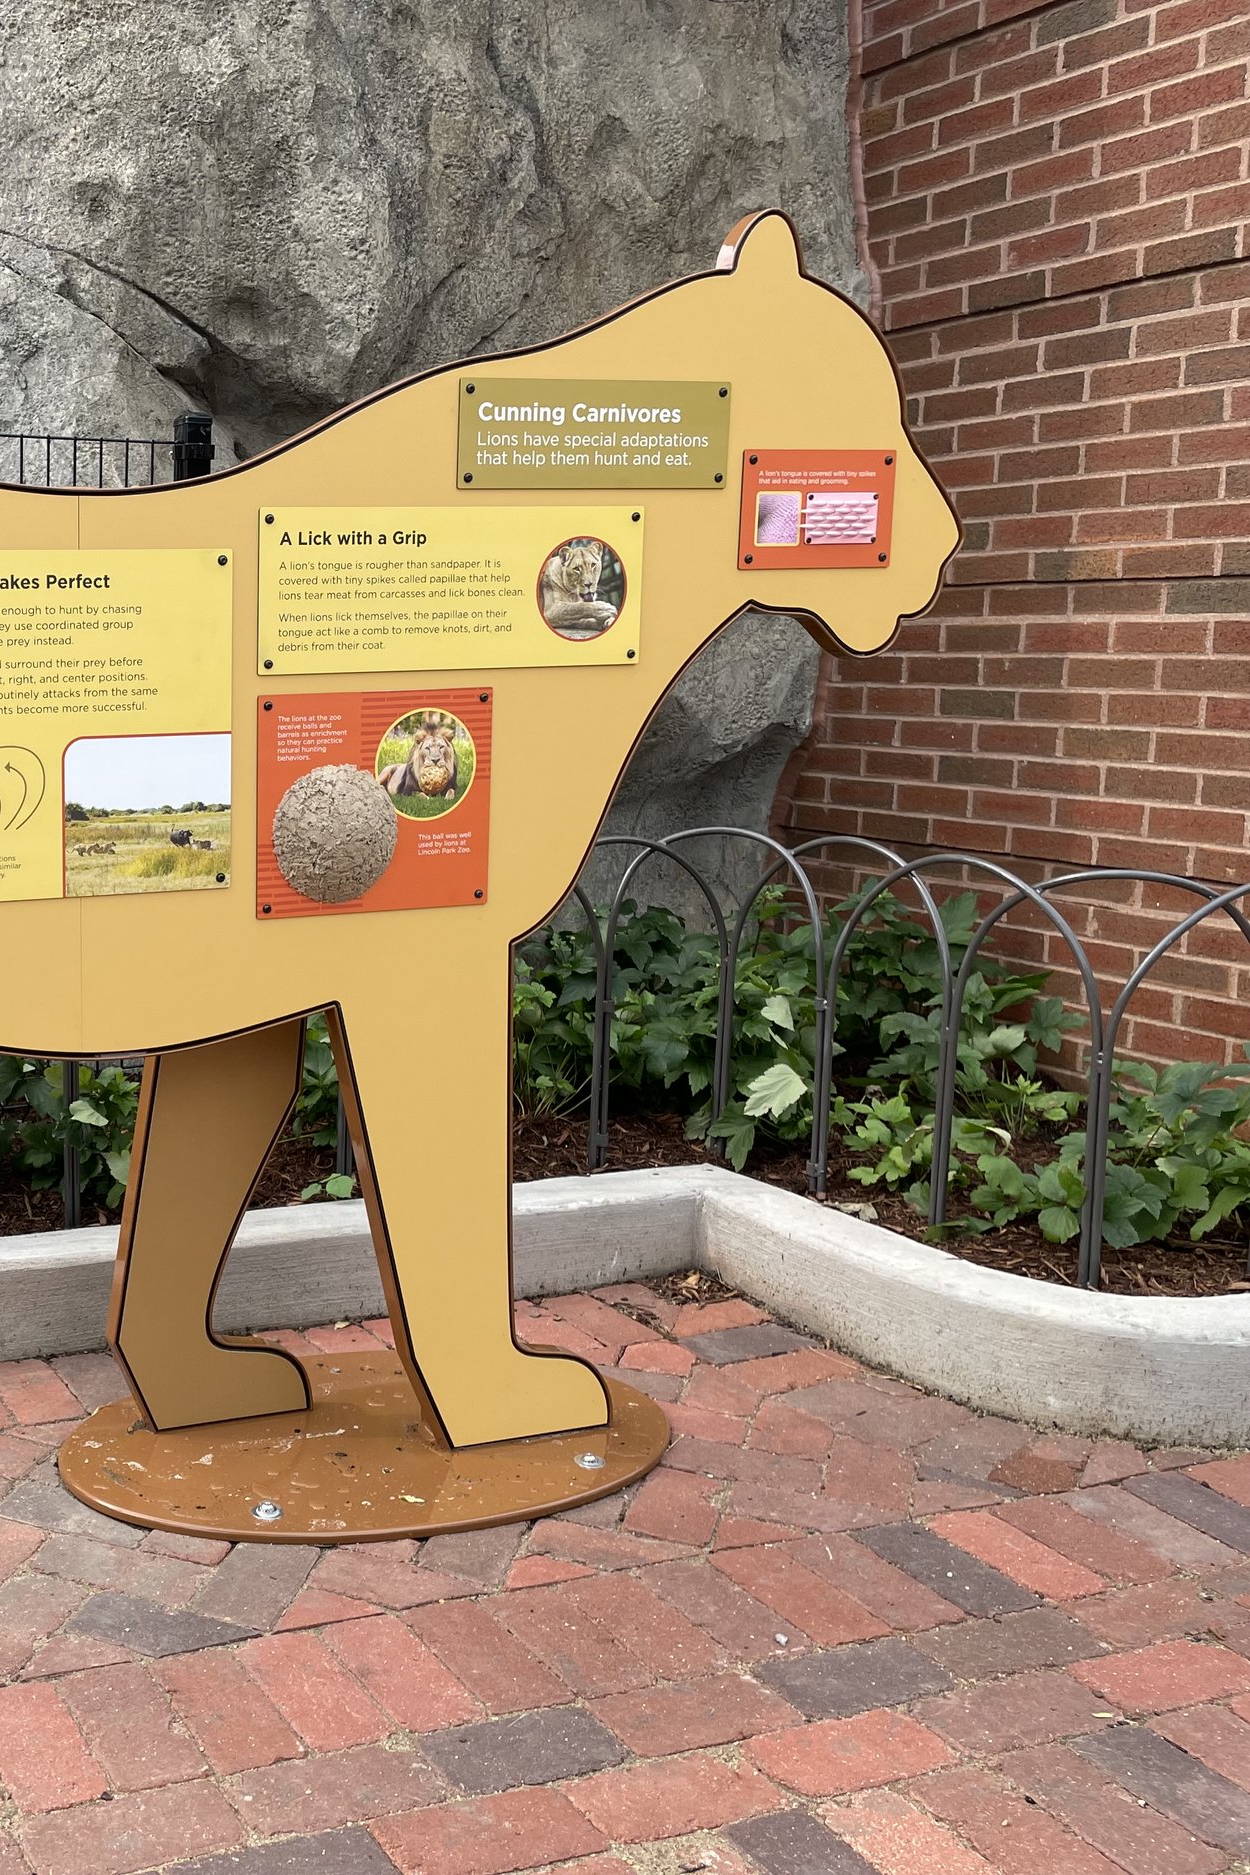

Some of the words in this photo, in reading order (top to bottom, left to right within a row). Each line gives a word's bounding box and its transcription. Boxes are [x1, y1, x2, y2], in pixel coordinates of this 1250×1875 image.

[479, 402, 565, 426] Cunning
[573, 403, 681, 423] Carnivores
[478, 431, 518, 447] Lions
[524, 431, 559, 447] have
[564, 431, 616, 450] special
[621, 432, 709, 450] adaptations
[477, 450, 508, 465] that
[513, 450, 546, 469] help
[551, 450, 589, 465] them
[595, 450, 628, 465] hunt
[633, 450, 661, 465] and
[665, 450, 691, 465] eat.
[280, 531, 292, 546] A
[299, 530, 332, 546] Lick
[337, 530, 372, 545] with
[378, 533, 387, 545] a
[393, 529, 427, 548] Grip
[279, 560, 287, 570] A
[318, 559, 353, 572] tongue
[356, 559, 363, 569] is
[366, 559, 404, 572] rougher
[407, 559, 428, 569] than
[431, 558, 481, 571] sandpaper.
[485, 558, 491, 568] It
[494, 558, 501, 568] is
[47, 573, 110, 589] Perfect
[279, 575, 318, 585] covered
[321, 574, 342, 585] with
[345, 574, 363, 587] tiny
[366, 574, 396, 587] spikes
[399, 573, 427, 584] called
[430, 573, 466, 586] papillae
[469, 573, 488, 583] that
[491, 572, 511, 585] help
[1, 605, 42, 618] enough
[45, 605, 56, 615] to
[59, 605, 83, 615] hunt
[86, 605, 99, 617] by
[102, 604, 142, 617] chasing
[279, 612, 307, 622] When
[311, 611, 333, 622] lions
[336, 611, 352, 621] lick
[355, 610, 411, 622] themselves,
[414, 609, 429, 620] the
[432, 609, 469, 622] papillae
[471, 611, 483, 619] on
[486, 608, 507, 618] their
[14, 623, 32, 631] use
[36, 620, 99, 631] coordinated
[102, 622, 133, 632] group
[5, 658, 52, 669] surround
[56, 657, 80, 668] their
[83, 659, 106, 670] prey
[109, 656, 143, 667] before
[42, 687, 81, 698] attacks
[84, 687, 108, 697] from
[111, 686, 128, 696] the
[131, 687, 158, 696] same
[310, 729, 347, 737] enrichment
